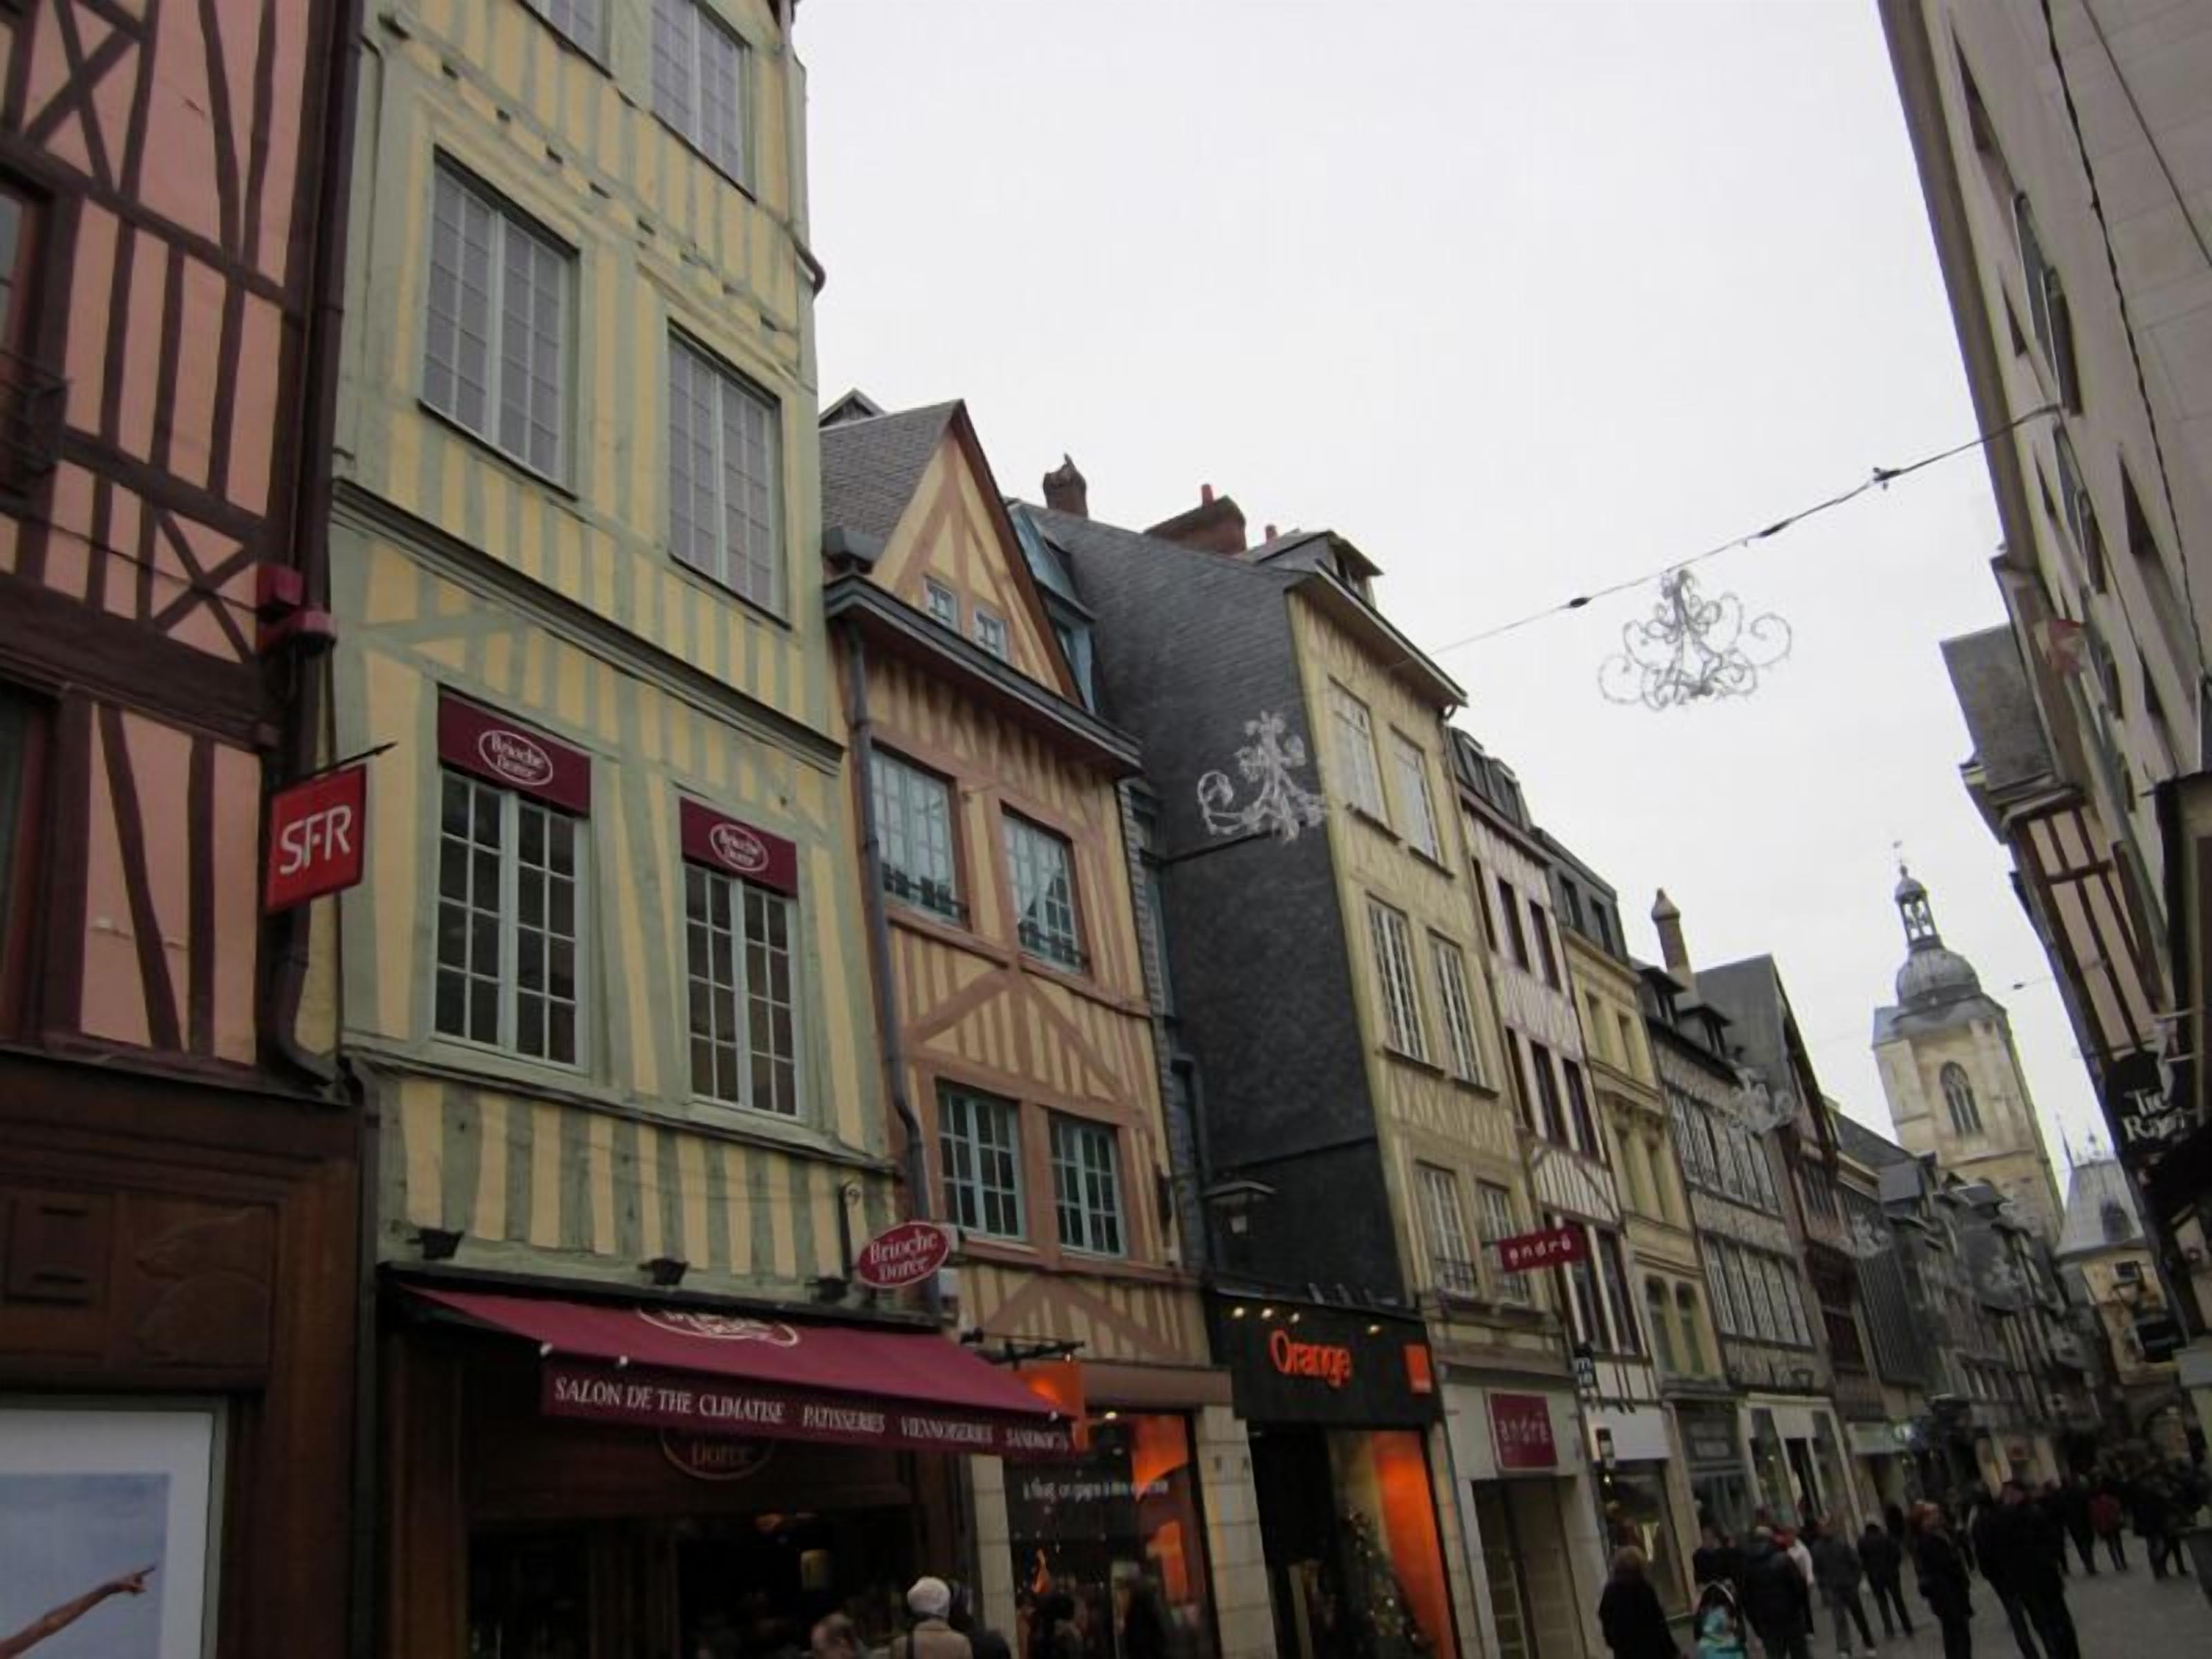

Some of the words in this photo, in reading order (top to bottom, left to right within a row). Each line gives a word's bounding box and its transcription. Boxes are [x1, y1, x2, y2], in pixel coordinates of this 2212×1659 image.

[279, 805, 351, 874] SFR
[870, 1228, 938, 1264] Brioche
[555, 1376, 621, 1406] SALON
[626, 1385, 654, 1410] DE
